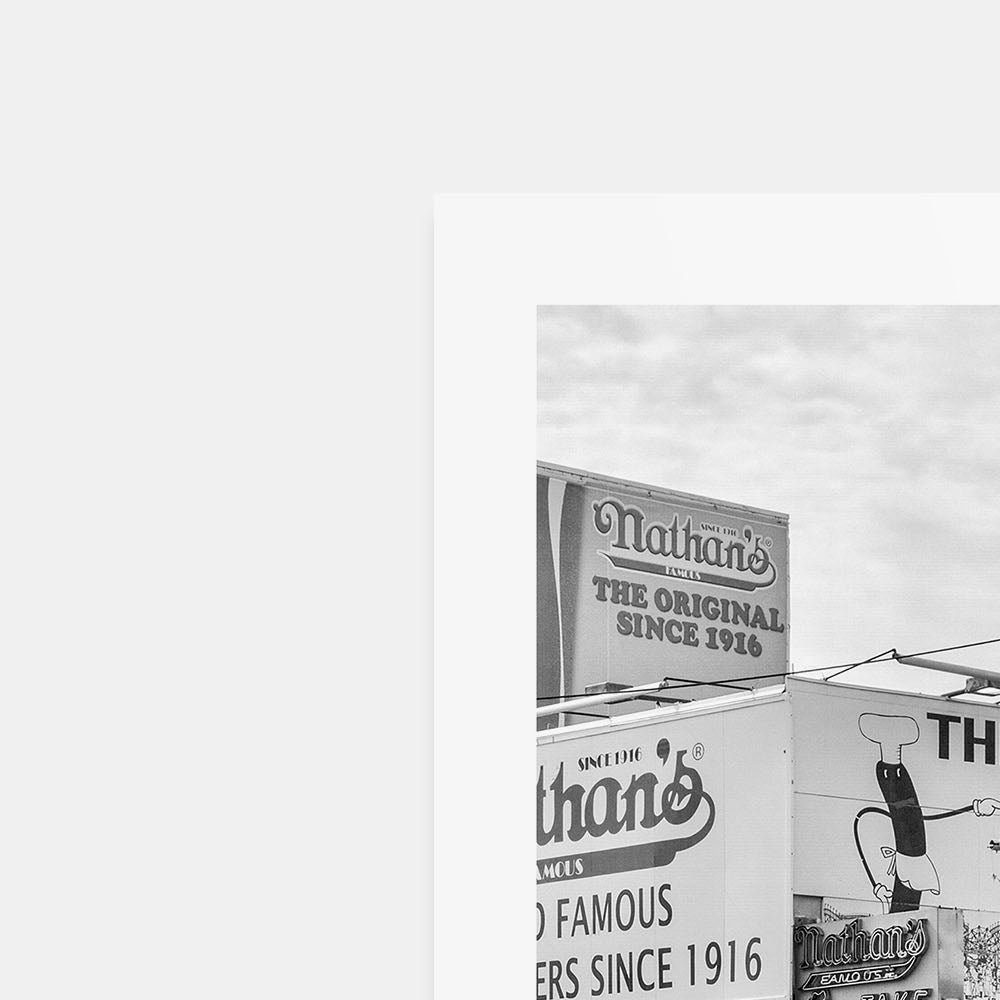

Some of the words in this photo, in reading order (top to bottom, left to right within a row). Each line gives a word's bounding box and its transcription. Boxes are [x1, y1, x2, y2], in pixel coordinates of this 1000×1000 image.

[593, 500, 769, 575] Nathan's
[592, 575, 648, 608] THE
[654, 587, 785, 633] ORIGINAL
[616, 611, 699, 647] SINCE
[705, 627, 763, 658] 1916
[578, 754, 613, 772] SINCE
[614, 747, 643, 765] 1916
[556, 883, 673, 939] FAMOUS
[591, 946, 673, 997] SINCE
[687, 937, 762, 986] 1916
[794, 918, 928, 969] Nathan's
